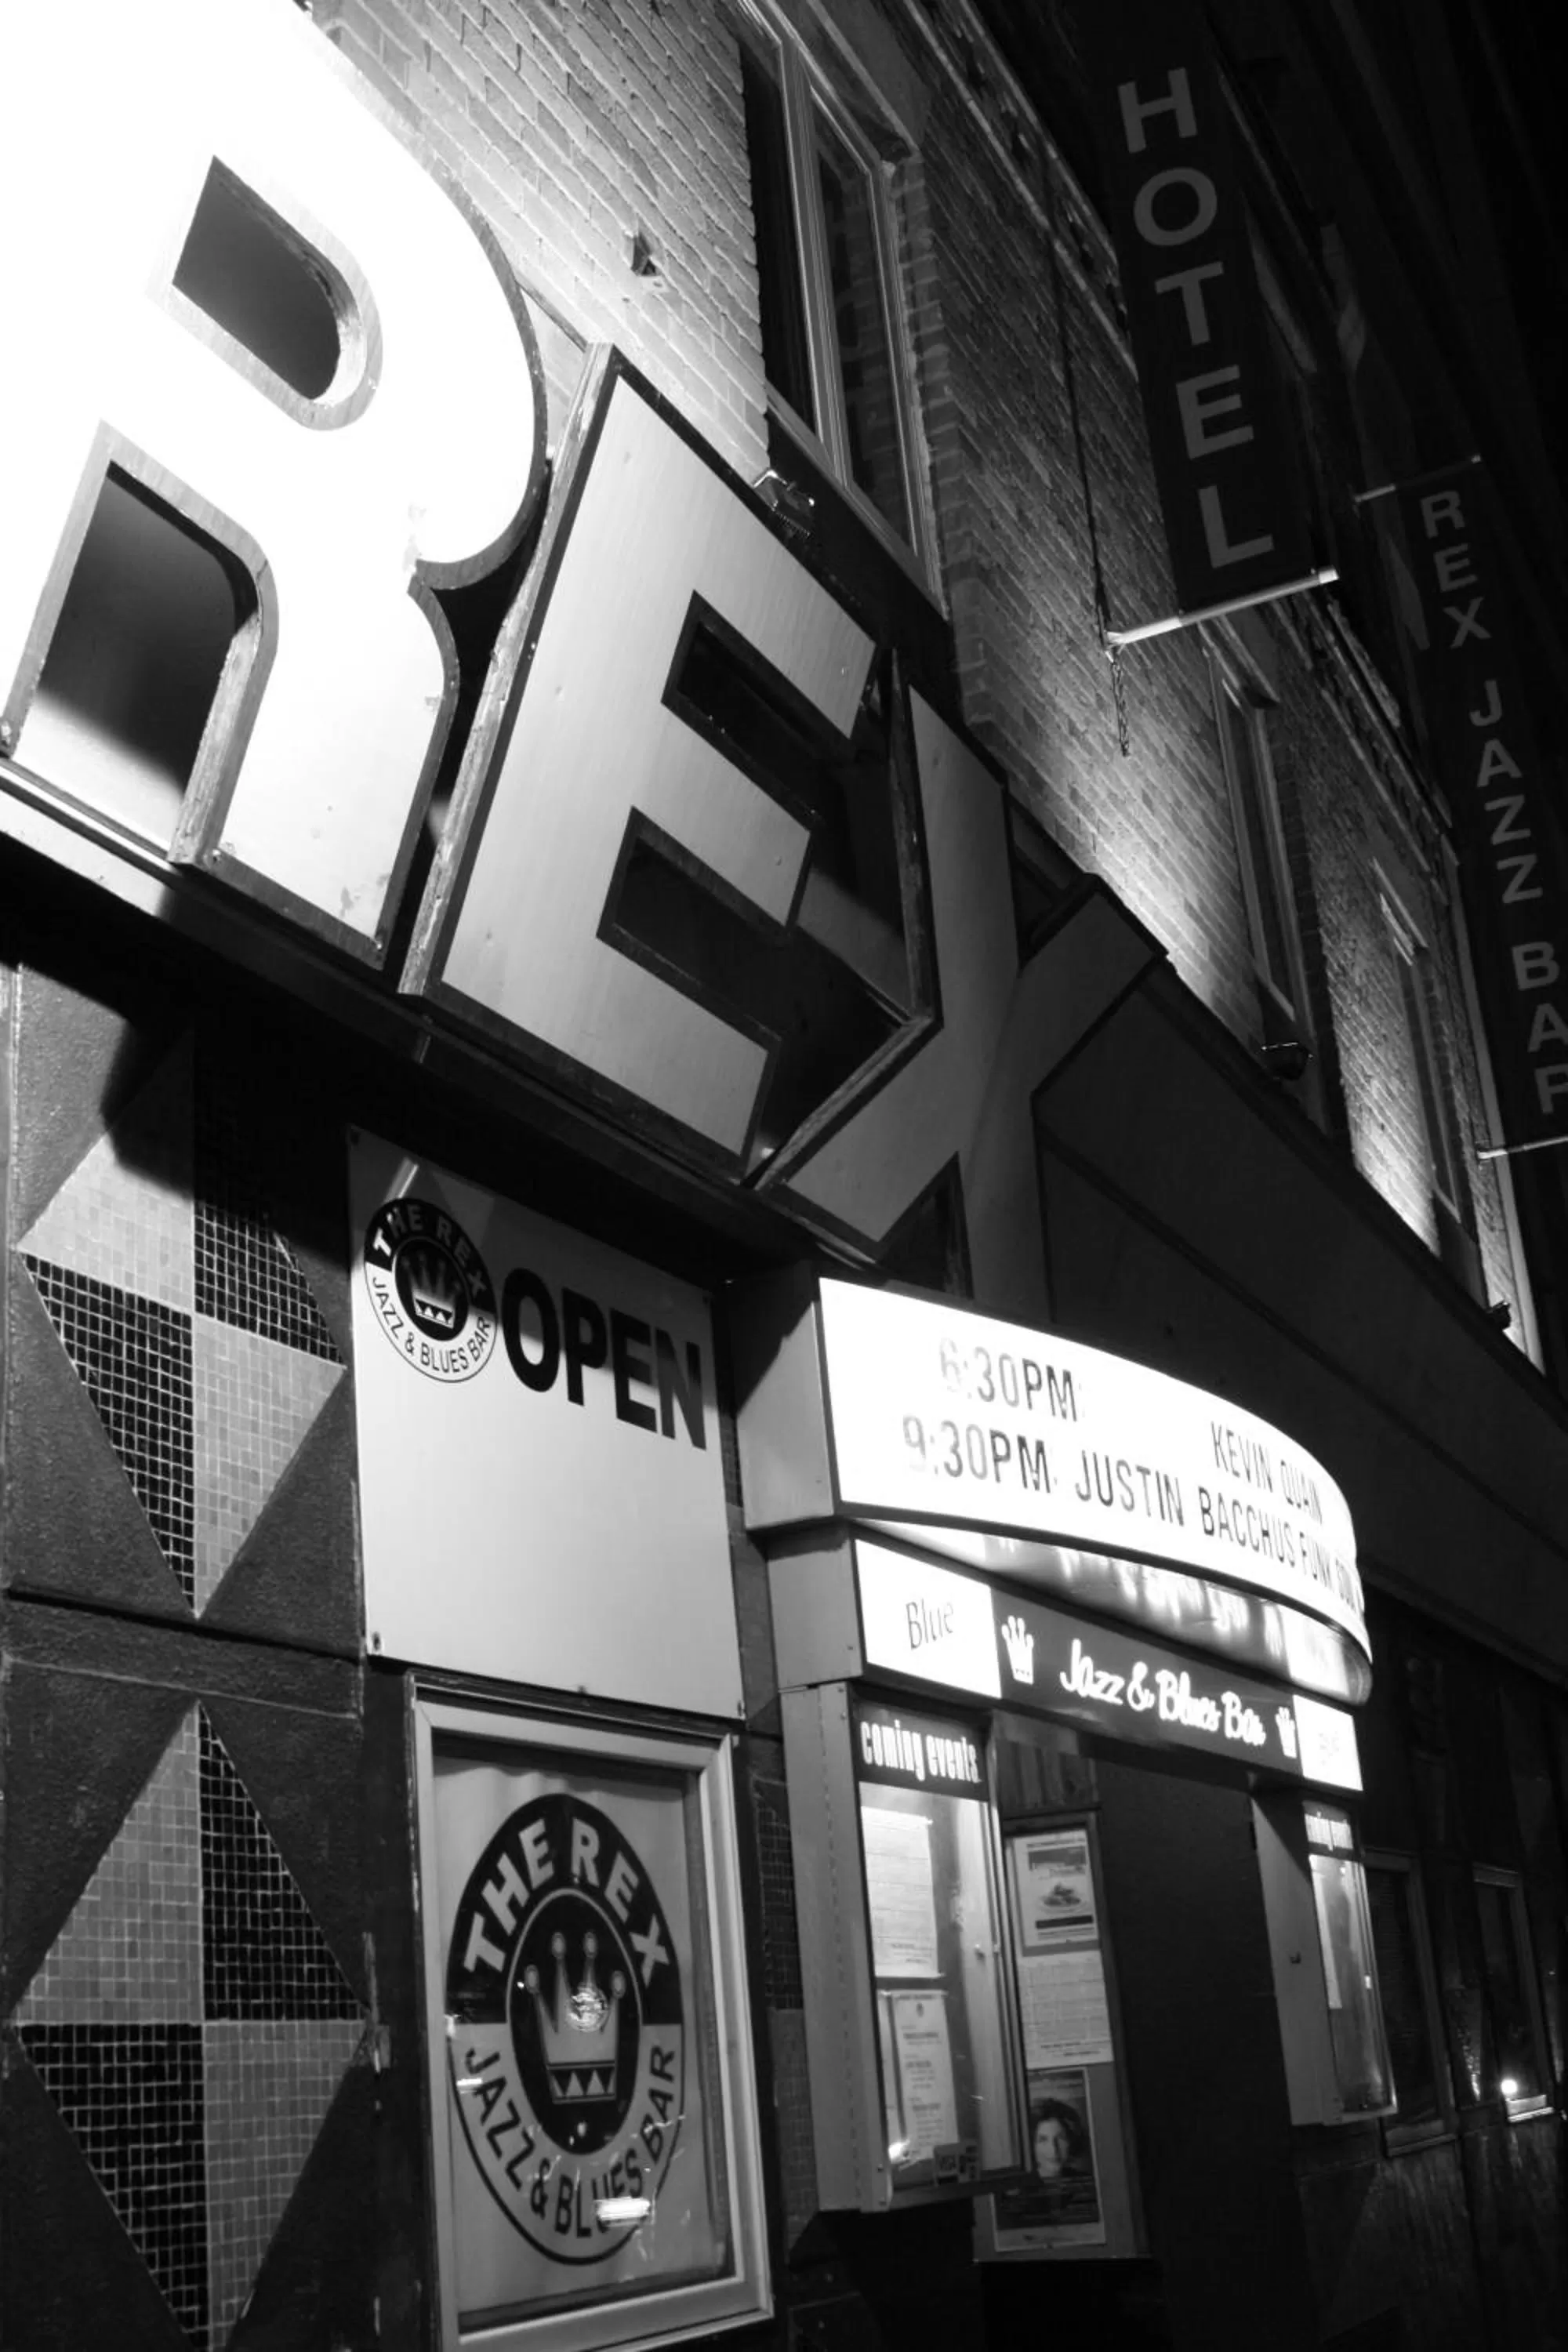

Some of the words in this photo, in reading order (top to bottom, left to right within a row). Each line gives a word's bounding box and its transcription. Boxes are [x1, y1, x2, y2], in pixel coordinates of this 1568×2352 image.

[1118, 67, 1273, 568] HOTEL
[0, 0, 1168, 1300] REX
[1421, 490, 1491, 648] REX
[1469, 681, 1543, 904] JAZZ
[374, 1204, 423, 1258] THE
[436, 1215, 488, 1295] REX
[372, 1276, 401, 1341] JAZZ
[405, 1332, 416, 1357] &
[420, 1341, 470, 1374] BLUES
[468, 1316, 492, 1363] BAR
[501, 1267, 706, 1450] OPEN
[1075, 1448, 1185, 1528] JUSTIN
[1197, 1484, 1296, 1569] BACCHUS
[1210, 1420, 1274, 1494] KEVIN
[905, 1597, 954, 1652] Blue
[862, 1720, 925, 1781] coming
[926, 1735, 981, 1783] events
[1060, 1638, 1126, 1706] Jazz
[1127, 1661, 1156, 1711] &
[1155, 1668, 1221, 1732] Blues
[1221, 1690, 1266, 1746] Bar
[463, 1818, 554, 1973] THE
[572, 1817, 670, 1987] REX
[464, 2047, 536, 2193] JAZZ
[530, 2158, 551, 2220] &
[640, 2044, 675, 2165] BAR
